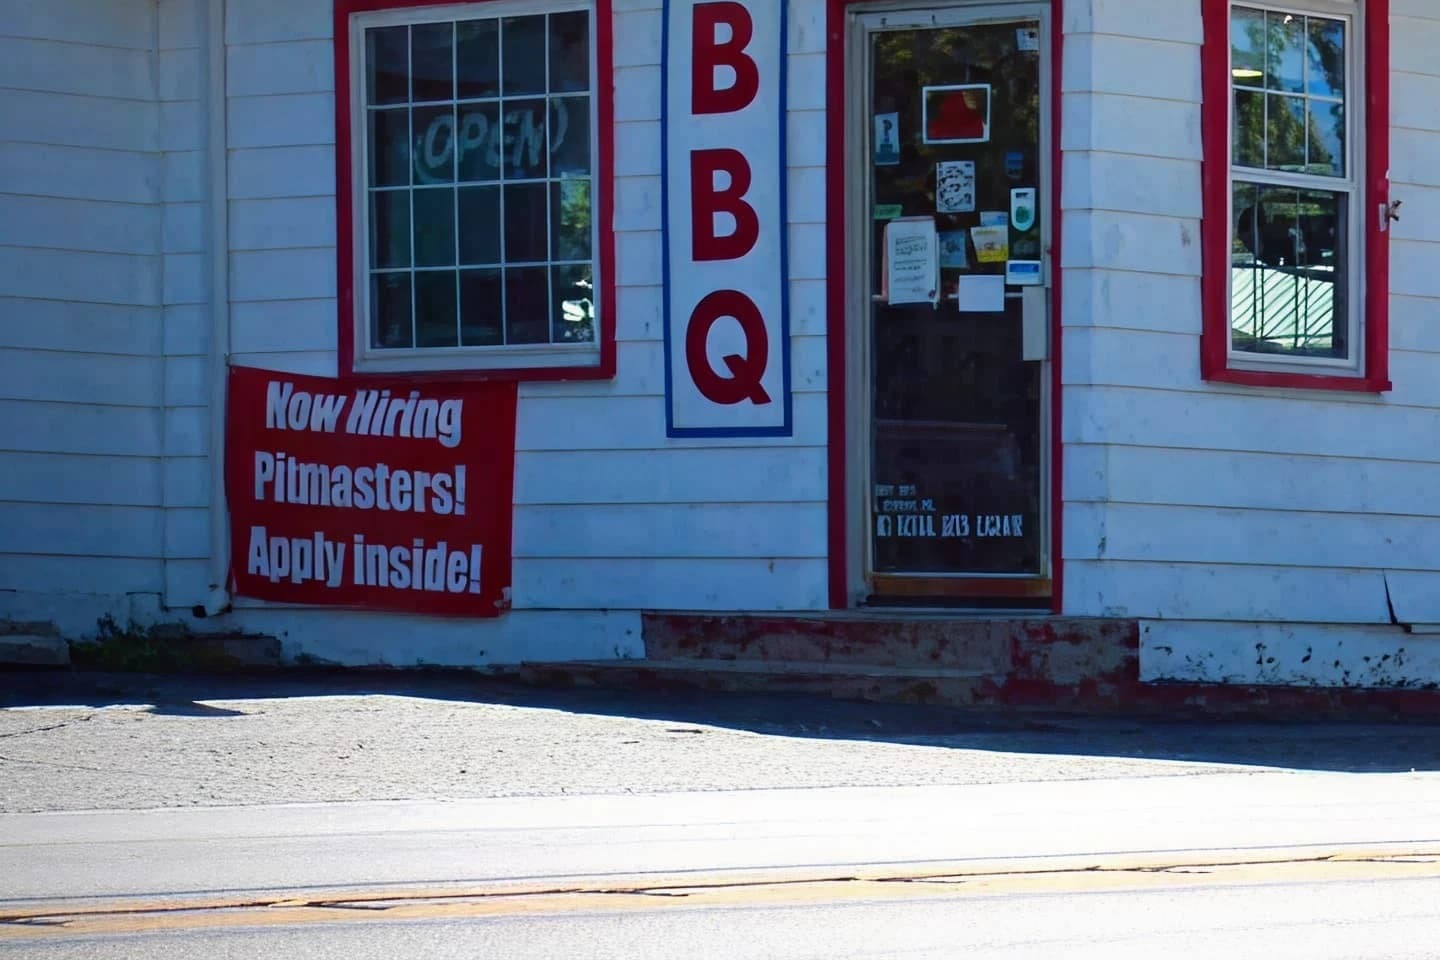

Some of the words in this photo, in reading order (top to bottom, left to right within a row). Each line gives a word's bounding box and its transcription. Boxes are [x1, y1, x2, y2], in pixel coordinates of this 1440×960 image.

[424, 108, 544, 169] OPEN
[685, 1, 772, 405] BBQ
[266, 381, 347, 433] Now
[346, 390, 464, 448] Hiring
[254, 451, 466, 516] Pitmasters!
[248, 526, 346, 588] Apply
[354, 534, 483, 594] inside!
